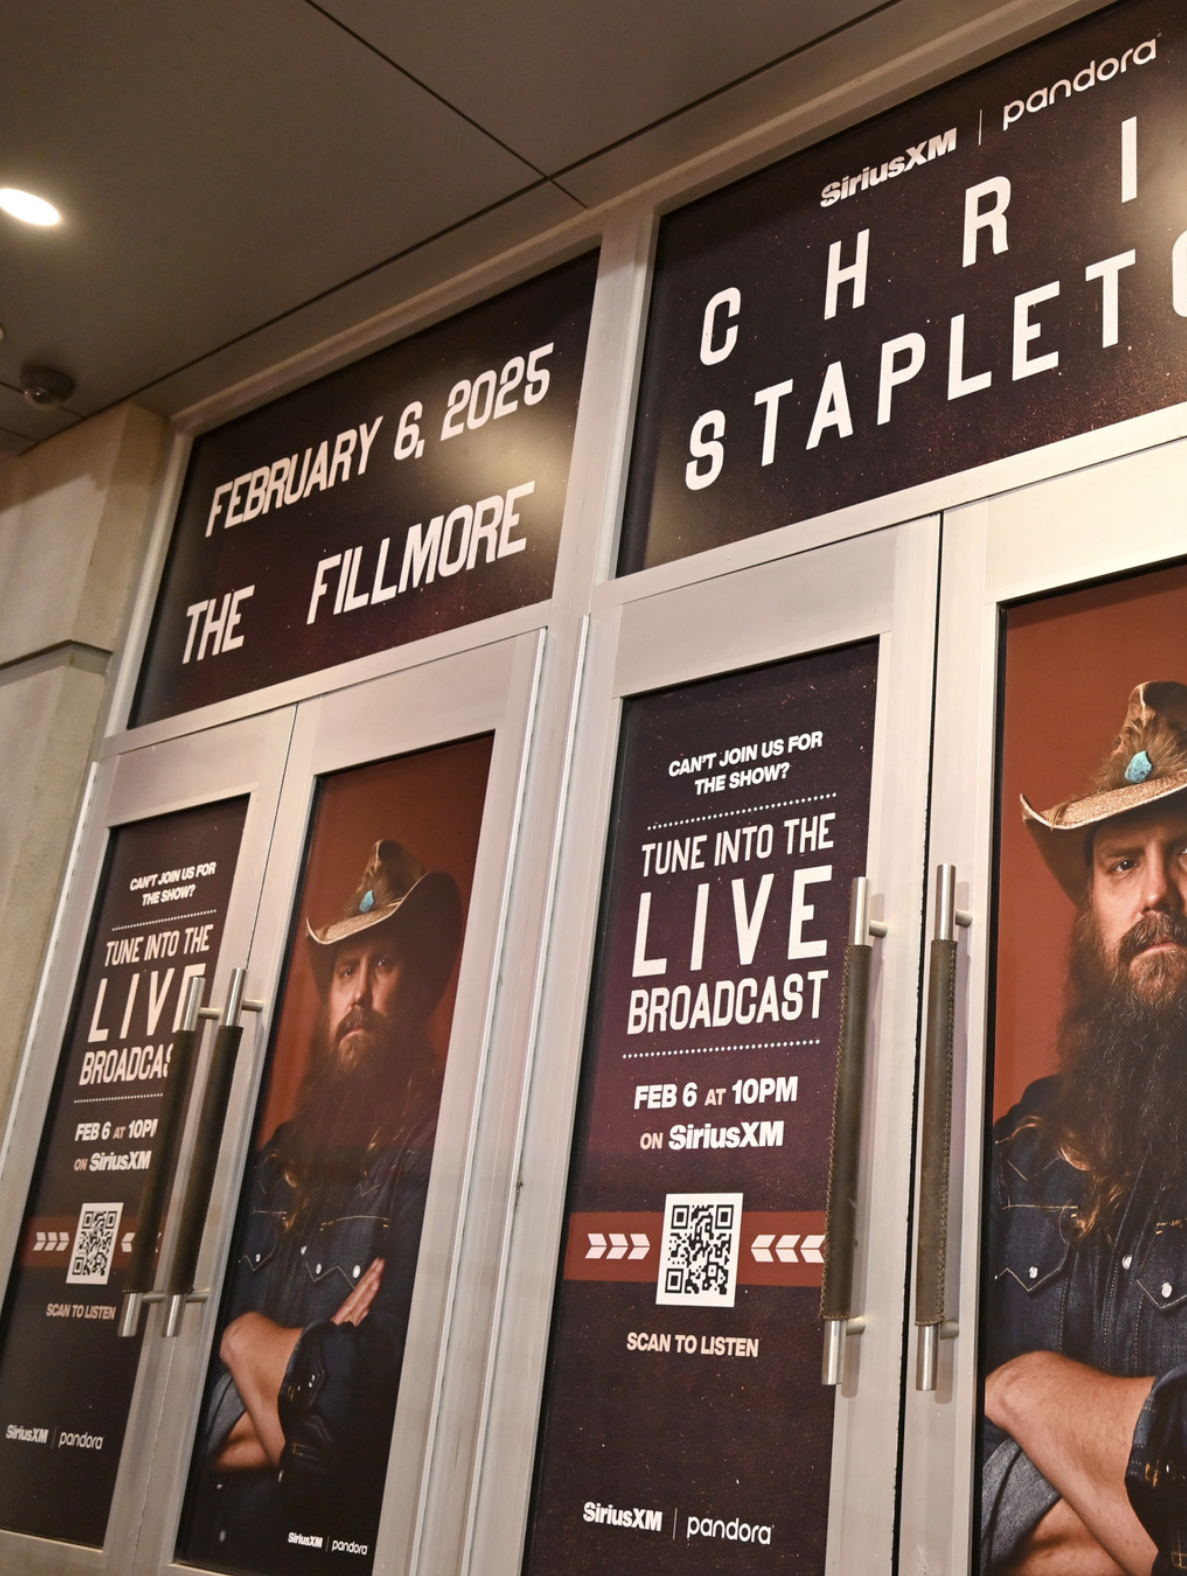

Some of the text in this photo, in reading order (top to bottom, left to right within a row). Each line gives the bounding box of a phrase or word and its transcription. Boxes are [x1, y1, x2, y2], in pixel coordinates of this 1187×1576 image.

[820, 38, 1157, 207] SiriusXM pandora
[205, 343, 554, 538] FEBRUARY 6, 2025
[182, 480, 535, 664] THE FILLMORE
[668, 731, 823, 778] CAN'T JOIN US FOR
[694, 762, 790, 796] THE SHOW?
[641, 812, 836, 877] TUNE INTO THE
[130, 861, 217, 891] CAN'T JOIN US FOR
[142, 884, 196, 906] THE SHOW?
[631, 865, 833, 978] LIVE
[104, 924, 214, 967] TUNE INTO THE
[627, 970, 829, 1035] BROADCAST
[79, 1043, 174, 1086] BROADCA
[634, 1076, 798, 1110] FEB 6 AT 10PM
[74, 1122, 101, 1141] FEB
[101, 1121, 112, 1140] 6
[112, 1126, 126, 1139] AT
[639, 1120, 785, 1151] ON SiriusXM
[73, 1150, 152, 1172] ON SiriusXM
[46, 1303, 117, 1320] SCAN TO LISTEN
[626, 1332, 759, 1358] SCAN TO LISTEN
[6, 1424, 104, 1450] SiriusXM pandora
[582, 1501, 772, 1545] SiriusXM pandora
[288, 1532, 368, 1555] SiriusXM pandora
